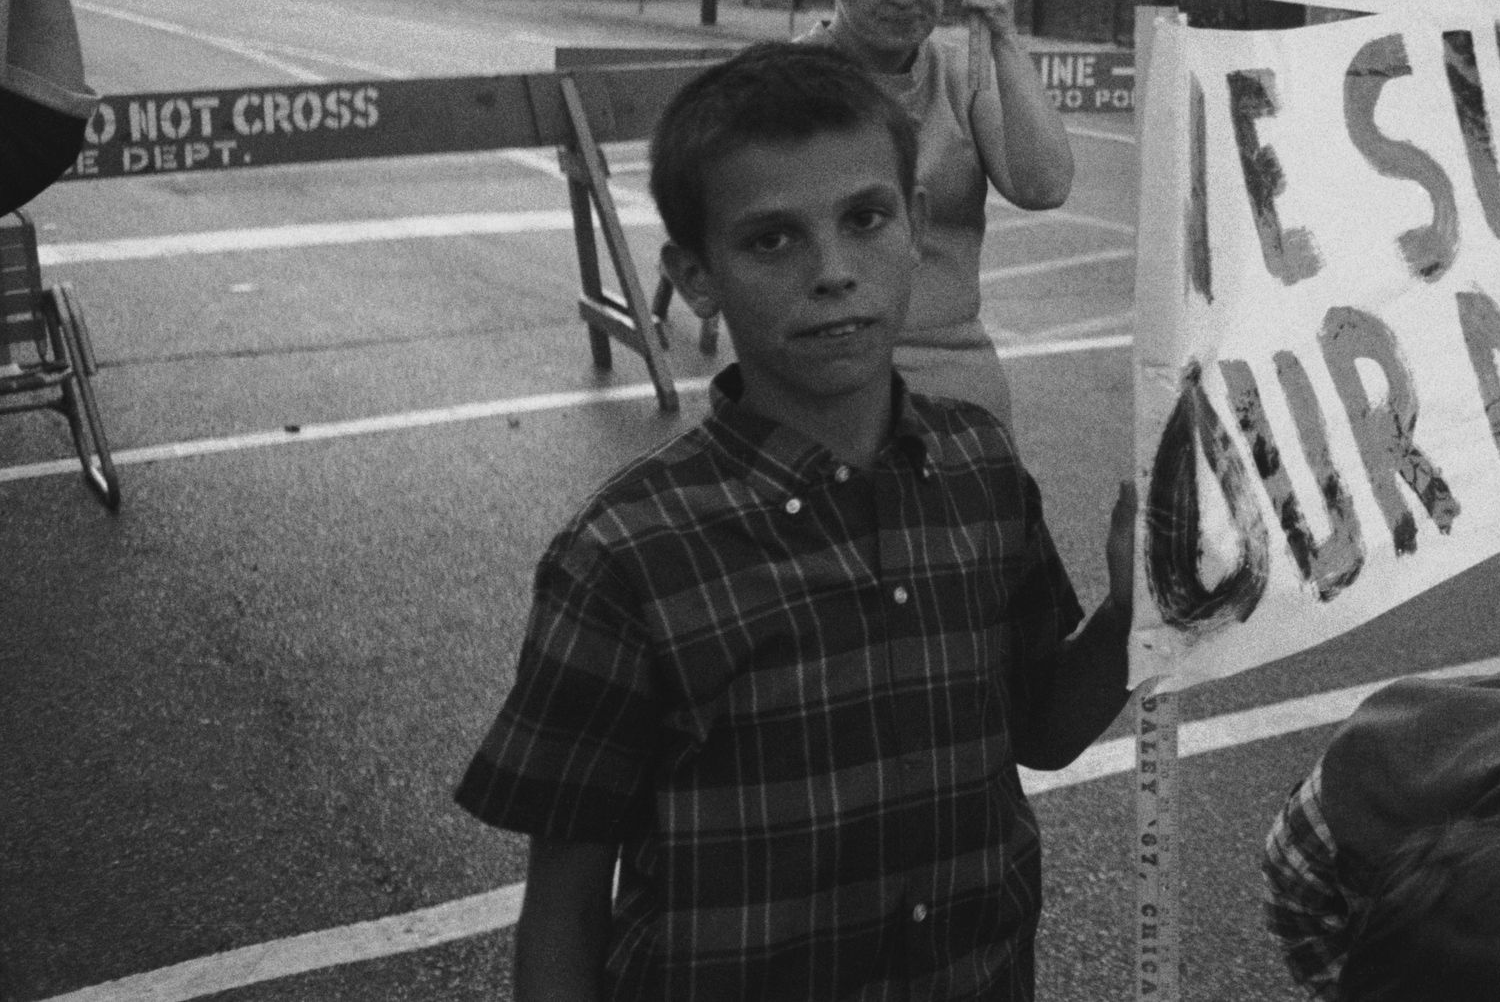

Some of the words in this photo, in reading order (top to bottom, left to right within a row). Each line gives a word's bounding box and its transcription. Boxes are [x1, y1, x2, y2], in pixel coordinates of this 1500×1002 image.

[1041, 56, 1096, 87] INE
[128, 97, 220, 142] NOT
[232, 87, 379, 135] CROSS
[122, 139, 252, 173] DEPT.
[1145, 304, 1461, 632] OUR
[1140, 697, 1158, 796] DALEY
